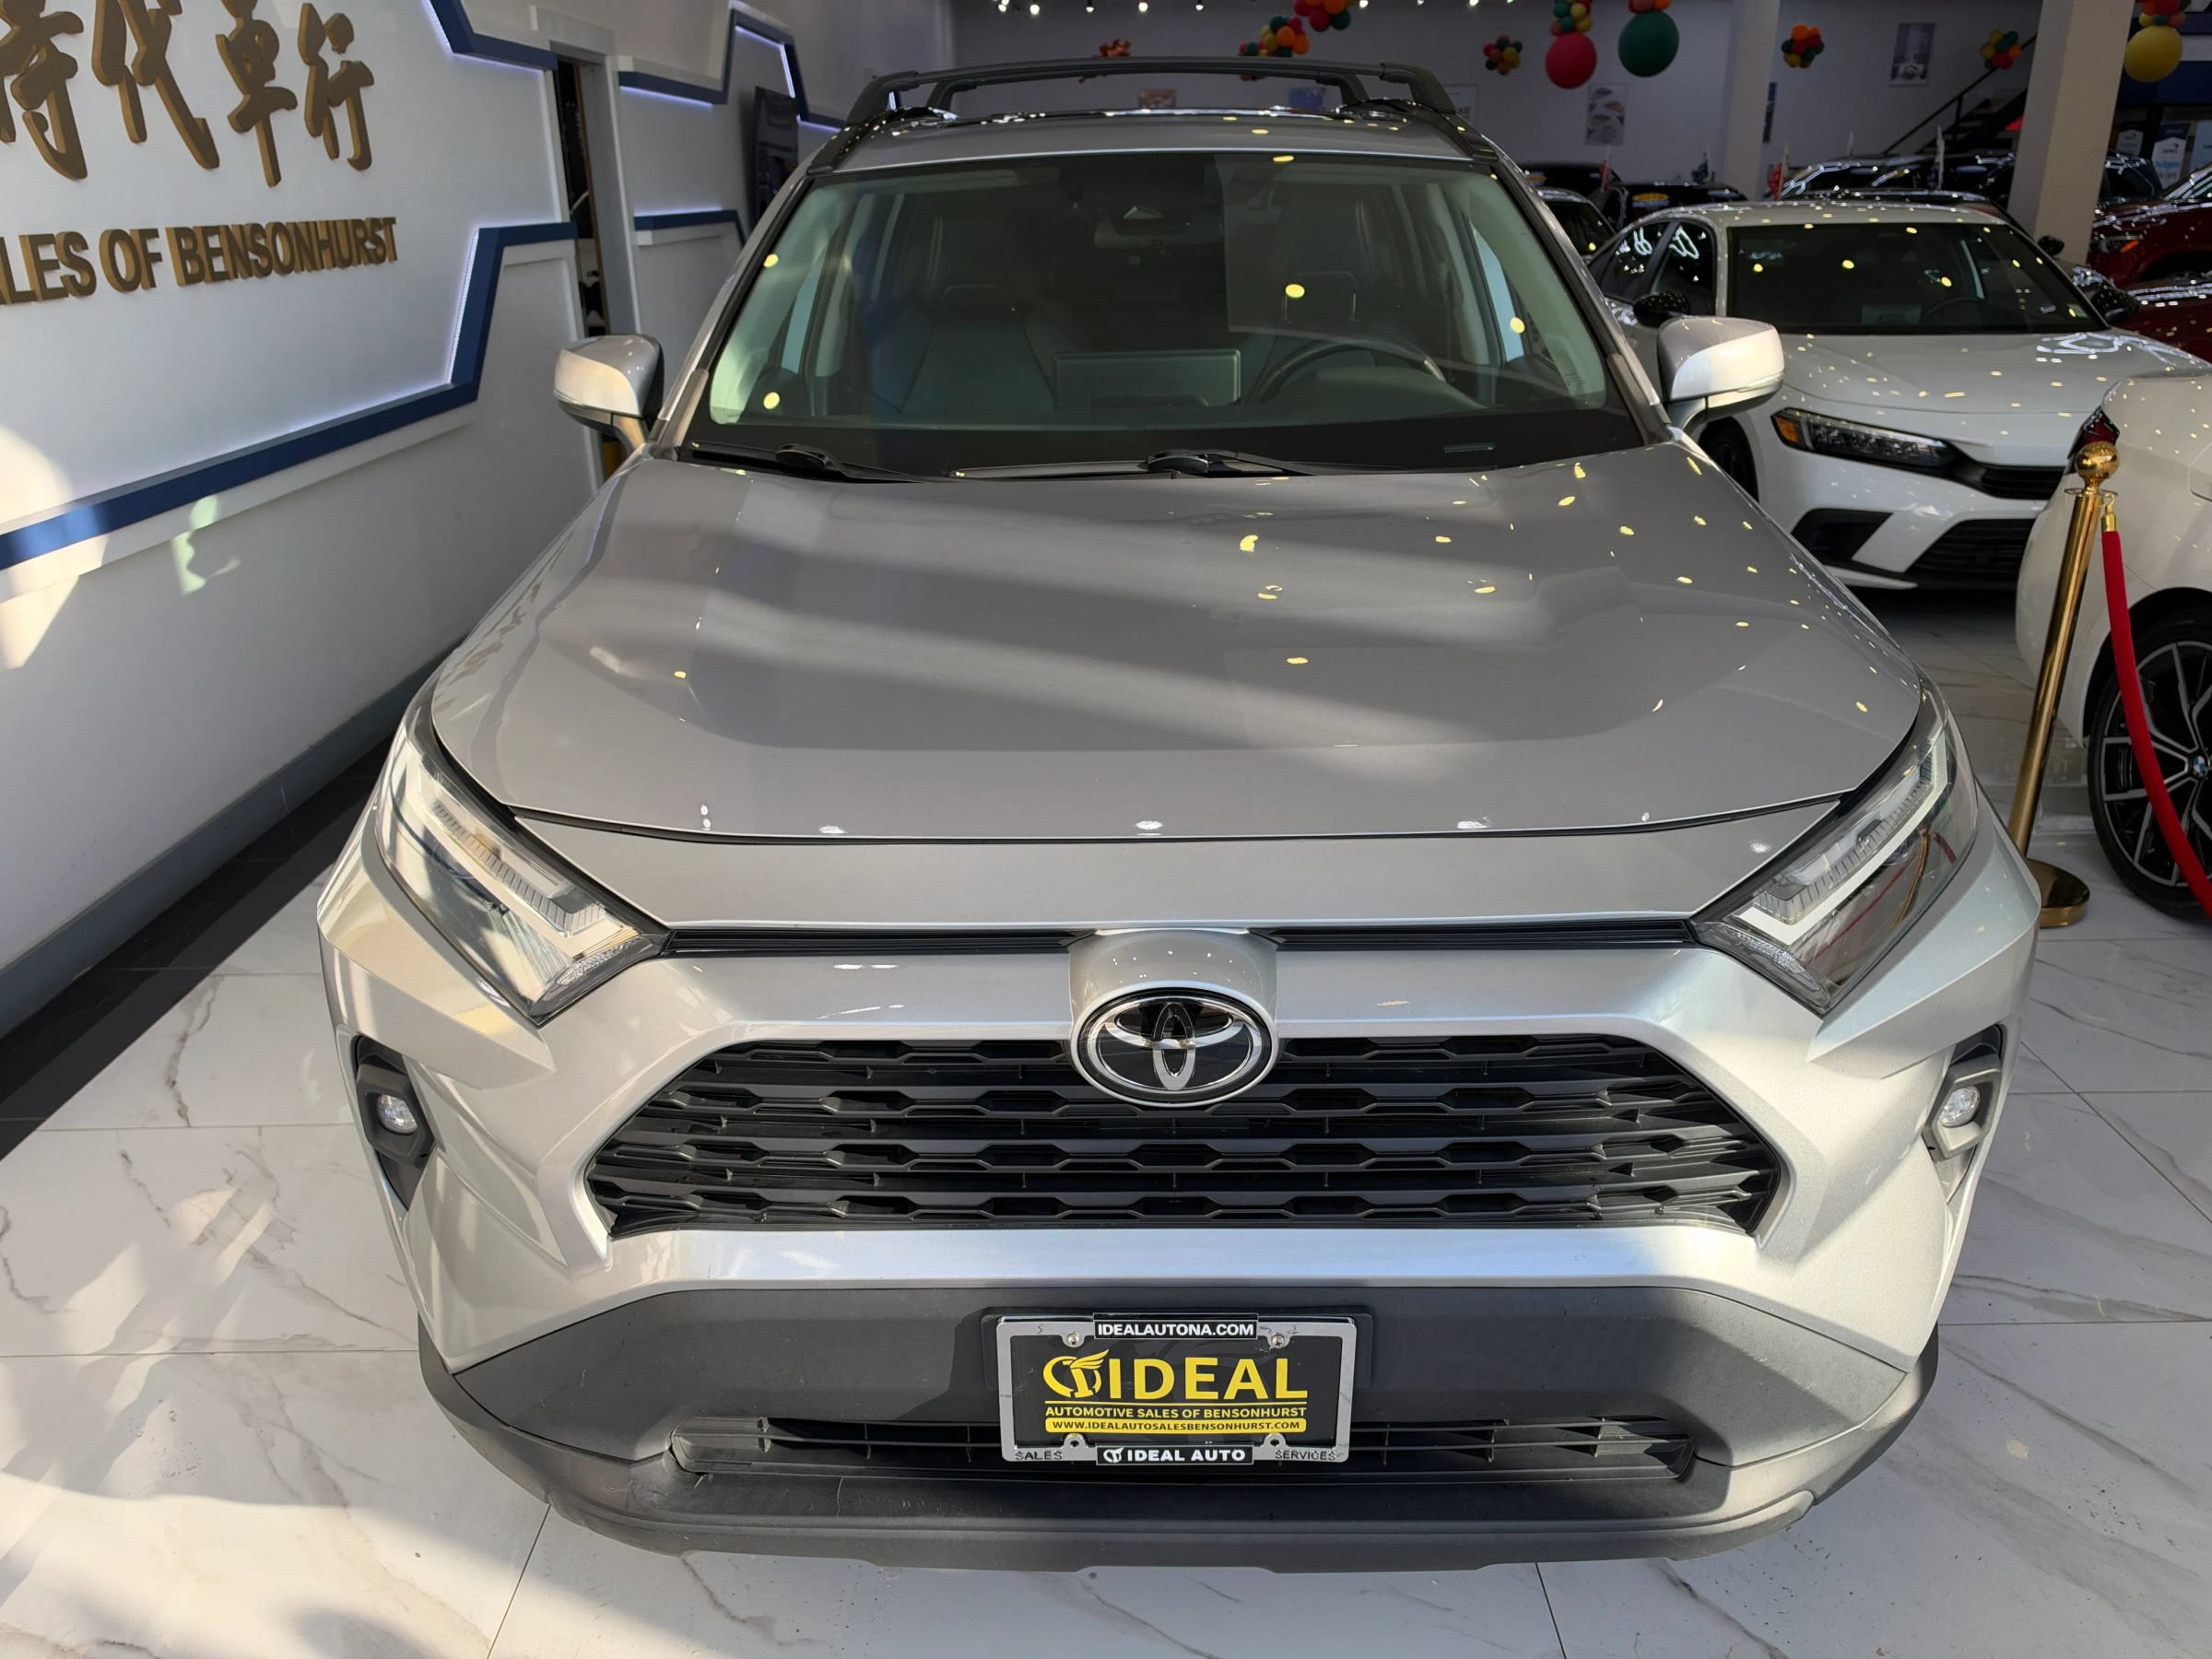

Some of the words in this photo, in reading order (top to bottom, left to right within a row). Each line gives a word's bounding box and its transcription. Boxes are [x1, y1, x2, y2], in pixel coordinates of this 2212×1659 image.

[0, 231, 97, 305] LES
[99, 228, 163, 293] OF
[165, 217, 398, 288] BENSONHURST
[1098, 1324, 1254, 1336] IDEALAUTONA.COM
[1108, 1357, 1309, 1400] IDEAL
[1045, 1406, 1134, 1418] AUTOMOTIVE
[1136, 1408, 1179, 1418] SALES
[1182, 1408, 1201, 1419] OF
[1204, 1407, 1307, 1418] BENSONHURST
[1053, 1421, 1300, 1431] WWW.IDEALAUTOSALESBENSONHURST.COM
[1015, 1451, 1063, 1461] SALES
[1127, 1450, 1185, 1462] IDEAL
[1191, 1449, 1246, 1462] AUTO
[1275, 1450, 1336, 1462] SERVICES
